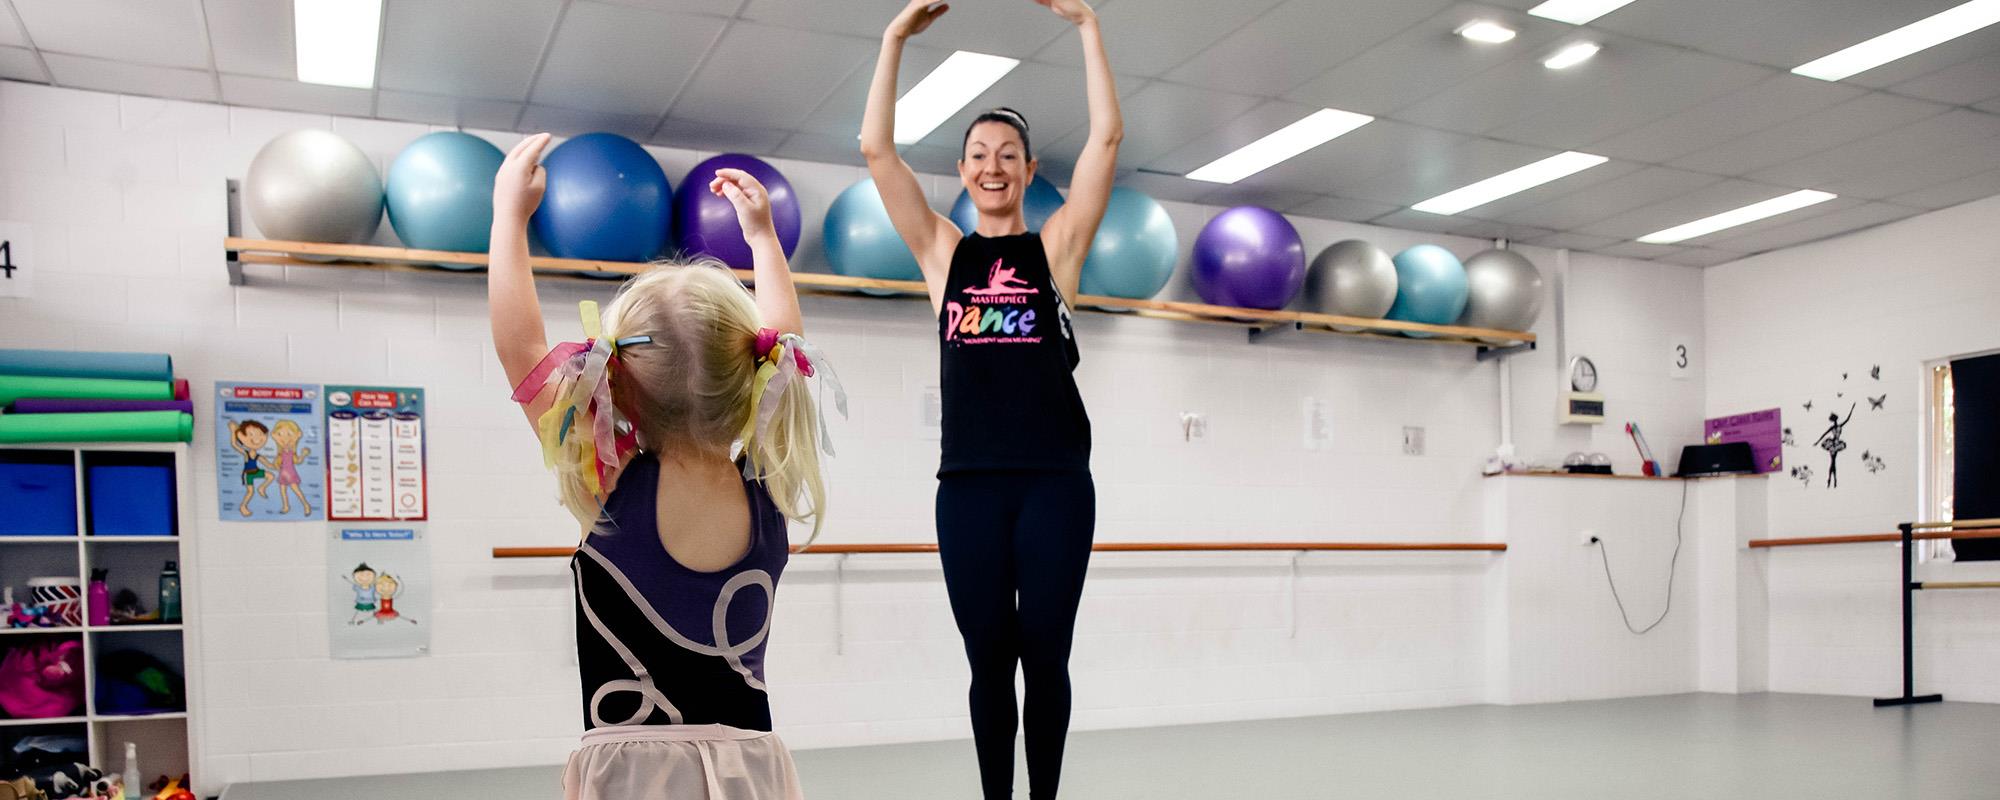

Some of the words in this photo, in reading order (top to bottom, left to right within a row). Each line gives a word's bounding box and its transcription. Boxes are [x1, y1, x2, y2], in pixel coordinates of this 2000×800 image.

[0, 240, 17, 278] 4
[970, 296, 1027, 304] MASTERPIECE
[946, 301, 1036, 341] Dance
[1676, 344, 1687, 369] 3
[237, 388, 250, 397] MY
[252, 389, 273, 398] BODY
[275, 390, 300, 399] PARTS
[360, 392, 376, 400] How
[377, 393, 389, 401] We
[357, 399, 372, 407] Can
[373, 400, 392, 408] Move
